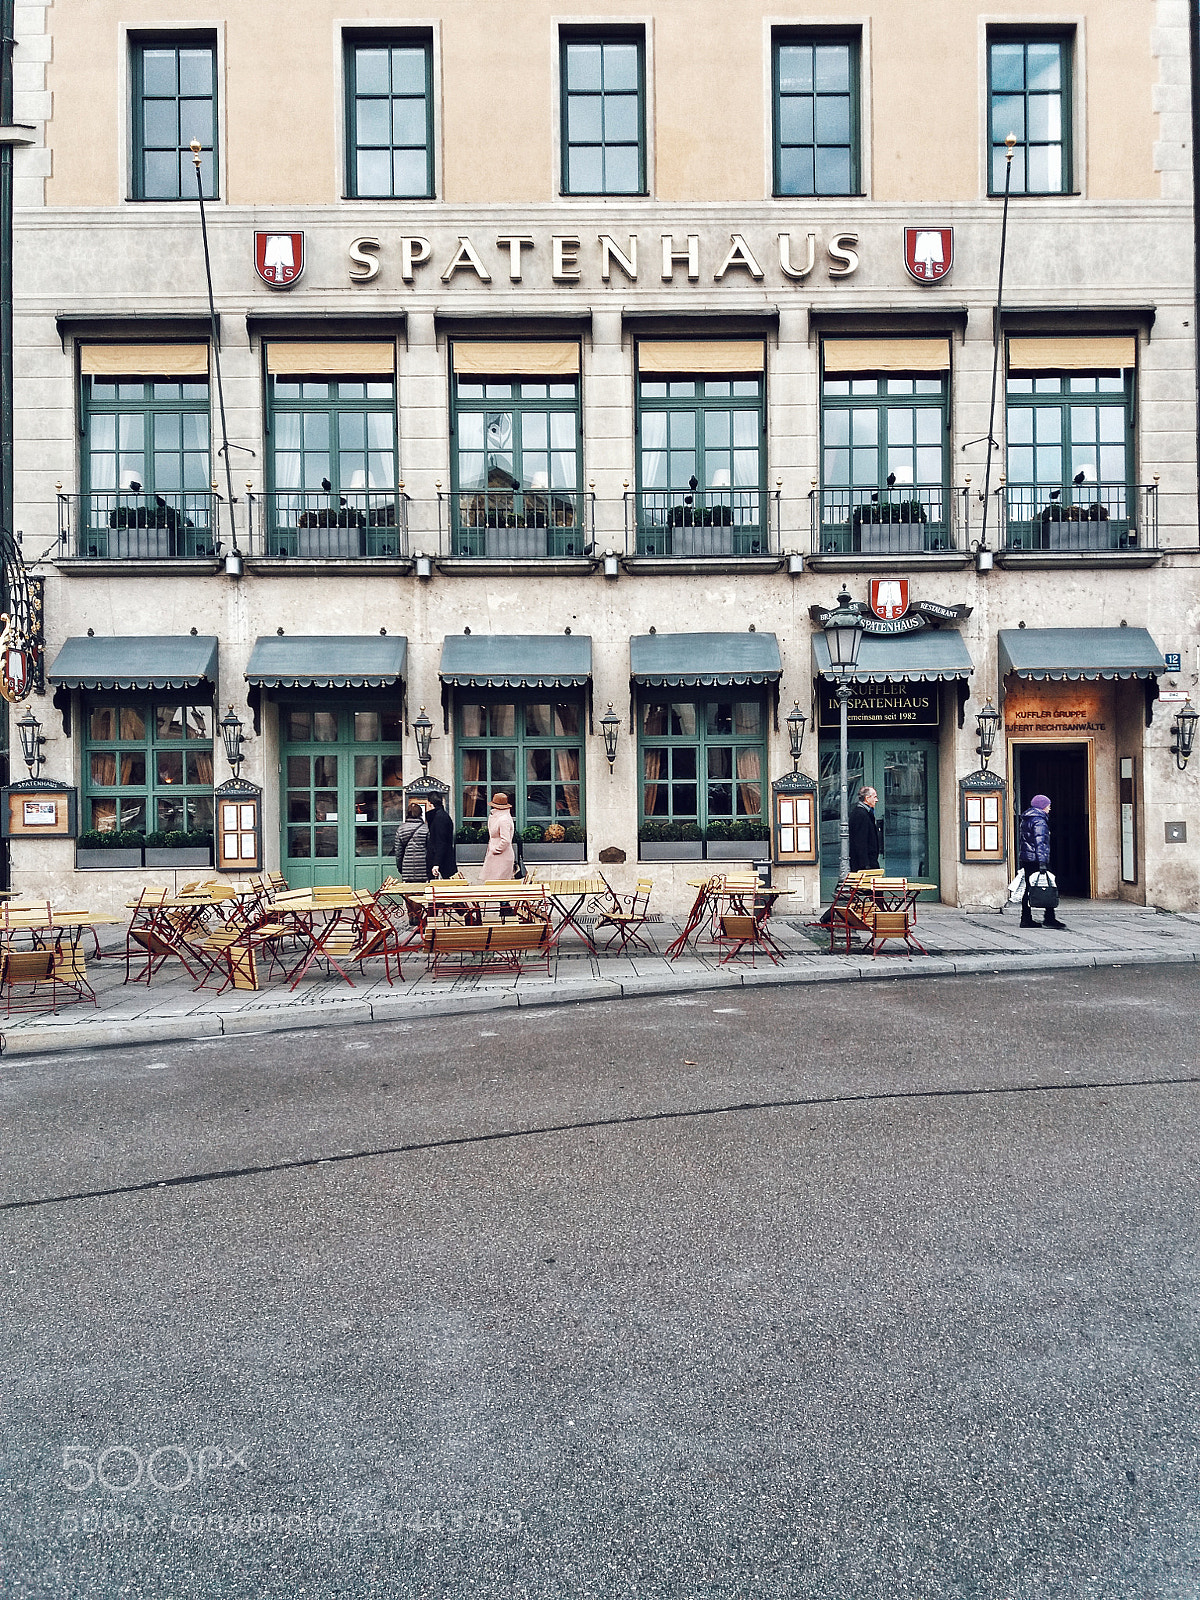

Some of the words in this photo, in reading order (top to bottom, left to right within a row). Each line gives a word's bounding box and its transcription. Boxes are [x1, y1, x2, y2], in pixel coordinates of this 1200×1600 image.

[348, 232, 860, 283] SPATENHAUS
[919, 603, 958, 618] RESTAURANT
[860, 617, 919, 632] SPATENHAUS
[1168, 654, 1179, 664] 12
[850, 684, 907, 696] KUFFLER
[847, 697, 929, 709] SPATENHAUS
[846, 712, 883, 721] emeinsam
[883, 712, 897, 720] seit
[899, 712, 917, 720] 1982
[1015, 711, 1051, 719] KUFFLER
[1053, 710, 1087, 718] GRUPPE
[1035, 722, 1106, 731] RECHTSANWÄLTE
[17, 780, 57, 788] SPATENHAUS
